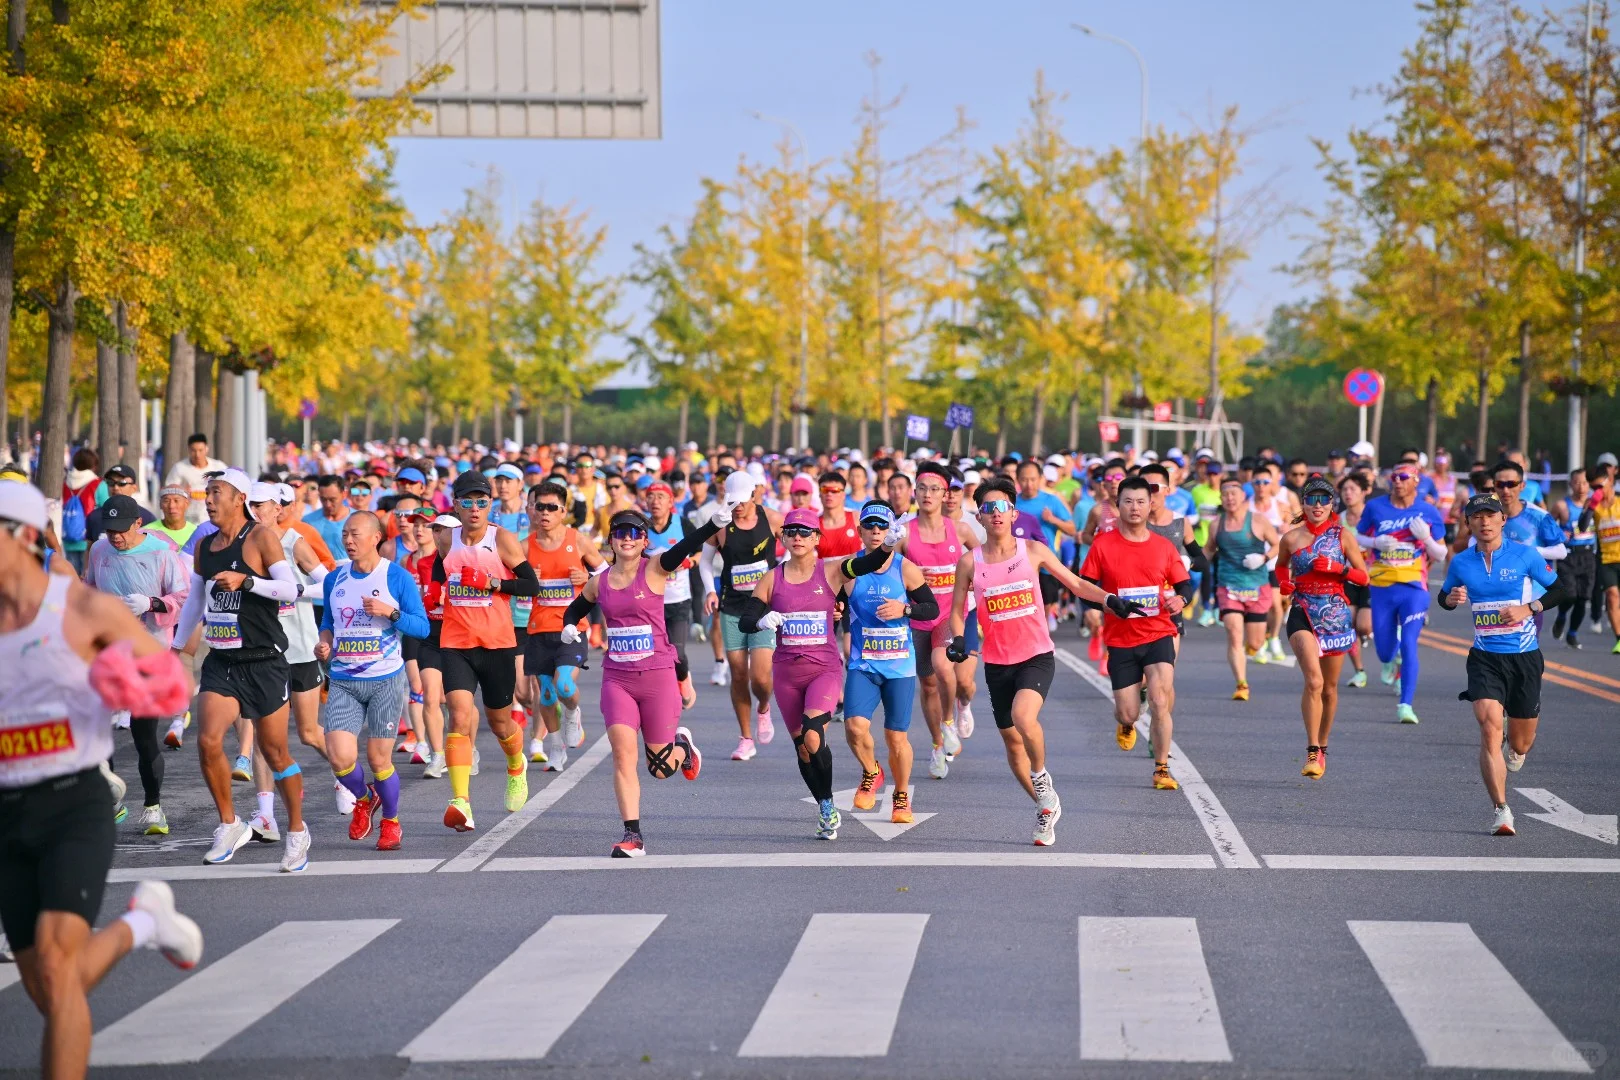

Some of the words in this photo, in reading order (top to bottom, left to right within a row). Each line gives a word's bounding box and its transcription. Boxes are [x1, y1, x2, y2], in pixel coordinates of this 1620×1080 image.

[988, 592, 1033, 612] D02338
[782, 624, 825, 635] A00095
[338, 640, 380, 653] A02052
[610, 638, 651, 651] A00100
[863, 639, 905, 650] A01857
[1321, 634, 1354, 649] A00221
